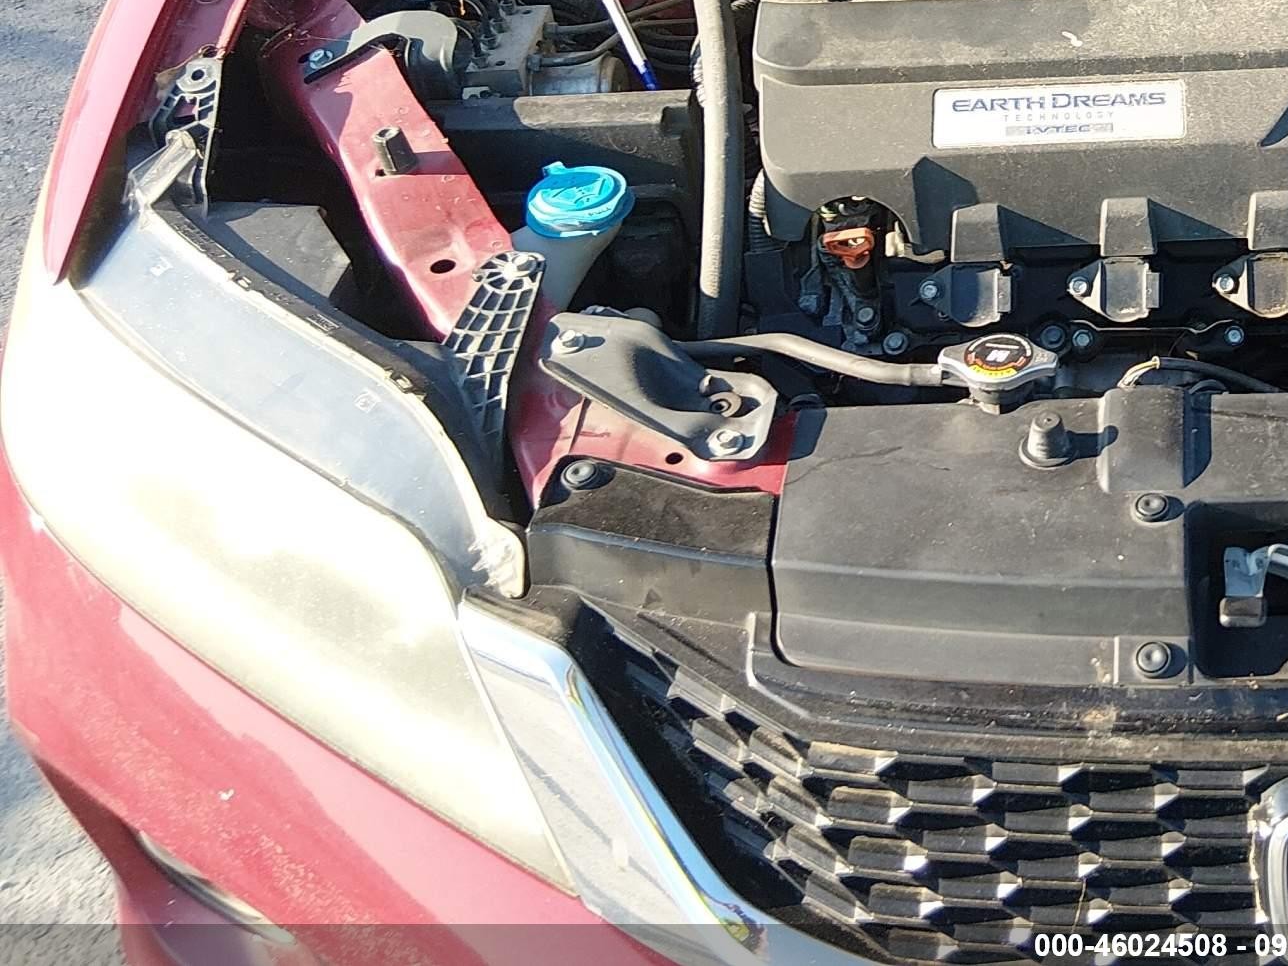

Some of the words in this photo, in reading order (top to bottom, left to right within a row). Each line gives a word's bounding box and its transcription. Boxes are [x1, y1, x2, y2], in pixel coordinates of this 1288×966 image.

[952, 98, 1046, 112] EARTH
[1052, 92, 1167, 109] DREAMS
[1004, 111, 1114, 122] TECHNOLOGY
